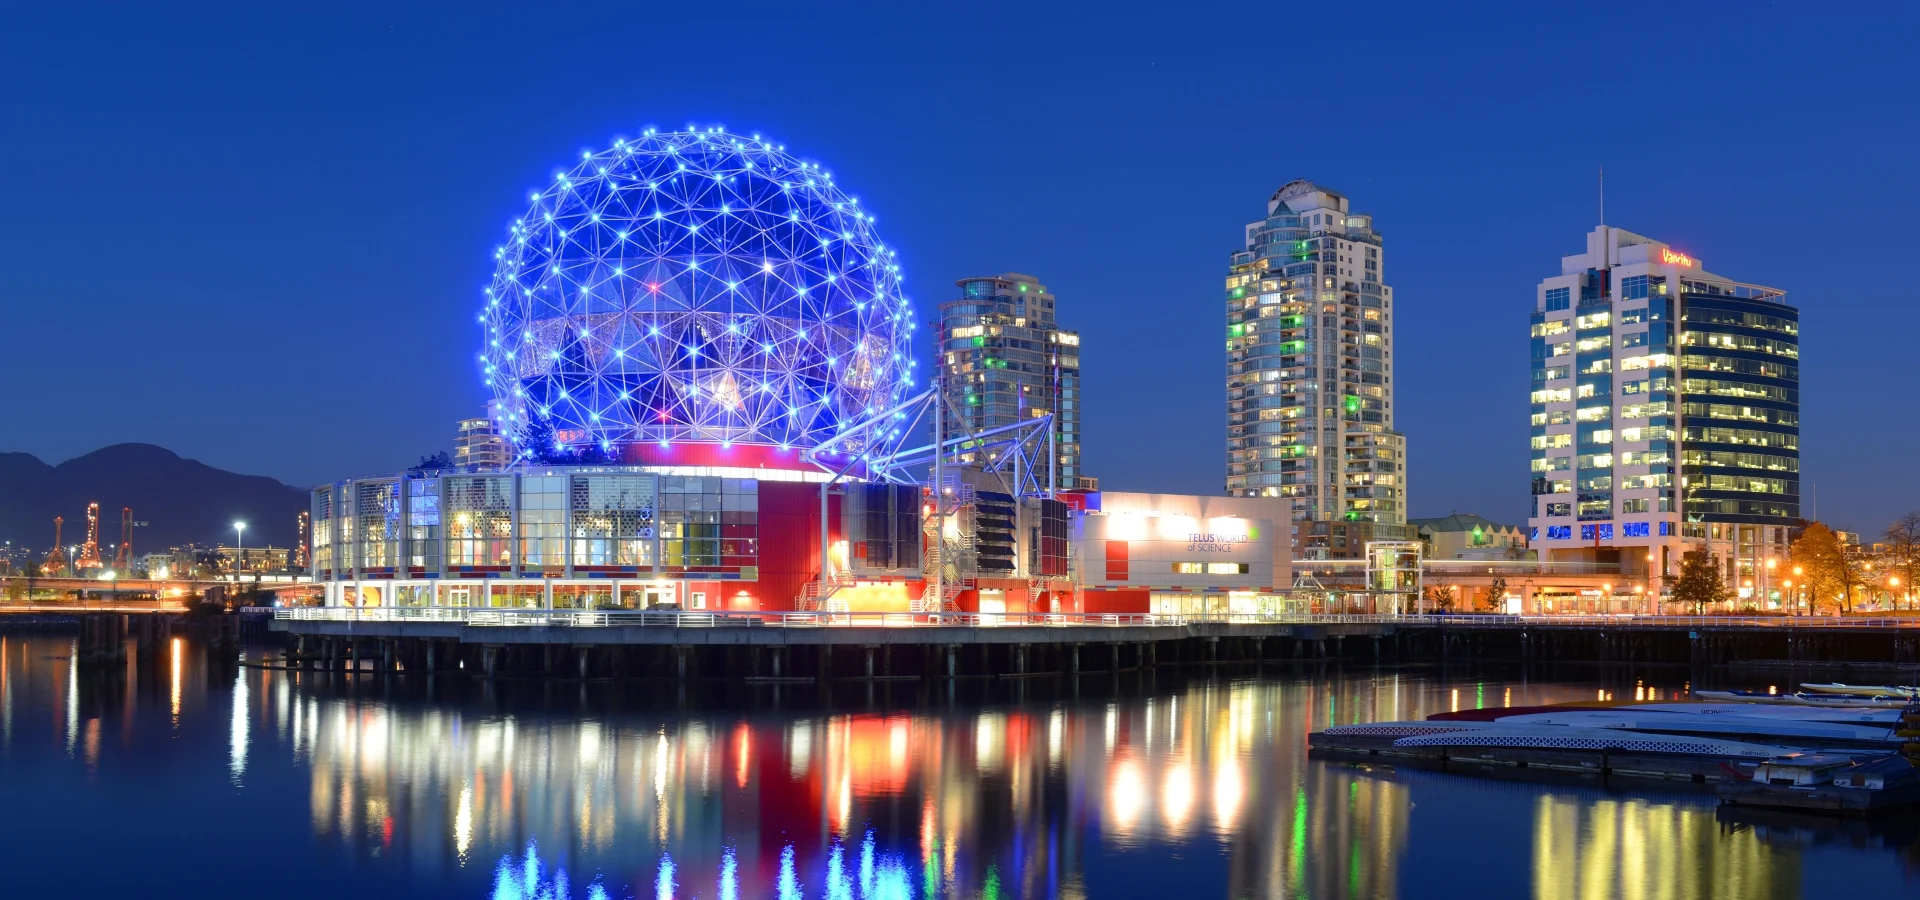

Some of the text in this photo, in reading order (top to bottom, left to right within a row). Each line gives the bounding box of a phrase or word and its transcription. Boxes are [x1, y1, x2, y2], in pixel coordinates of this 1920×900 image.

[1188, 533, 1248, 543] TELUS WORLD
[1187, 543, 1232, 553] of SCIENCE
